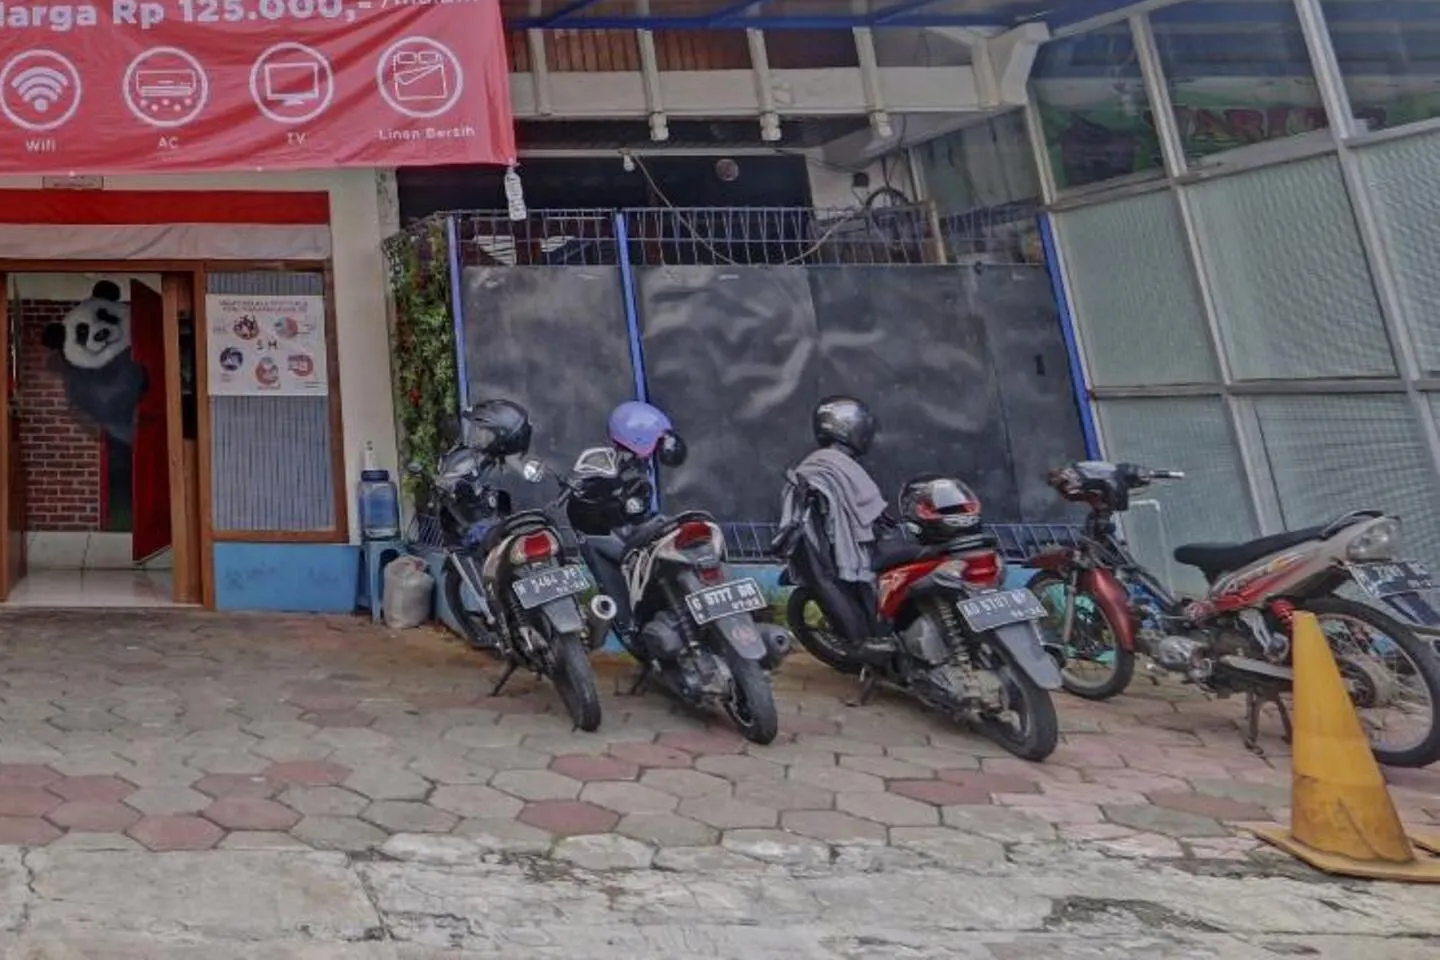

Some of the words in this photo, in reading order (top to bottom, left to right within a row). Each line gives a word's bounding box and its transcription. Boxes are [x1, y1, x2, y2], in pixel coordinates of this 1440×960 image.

[25, 137, 56, 153] Wifi
[158, 135, 180, 150] AC
[287, 132, 307, 146] TV
